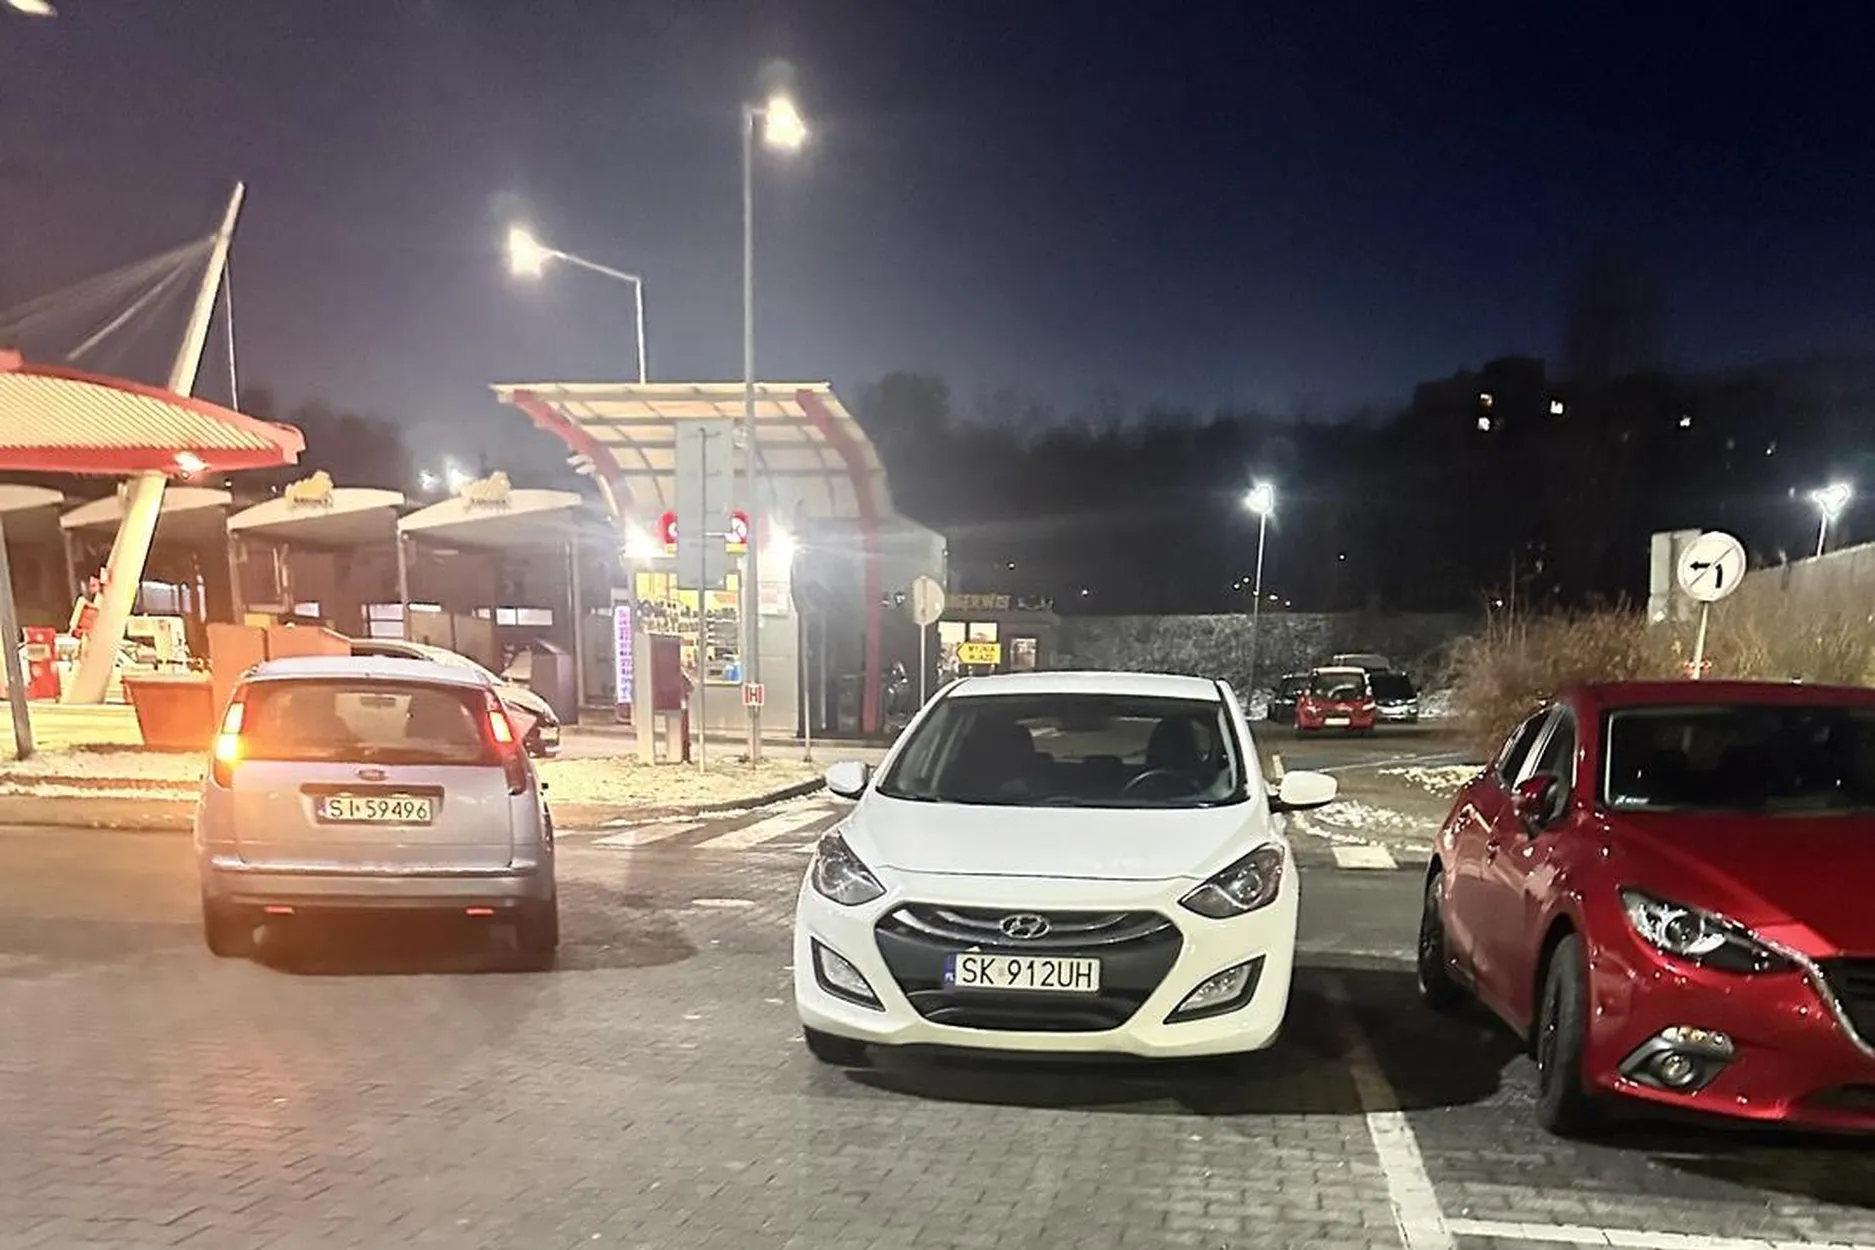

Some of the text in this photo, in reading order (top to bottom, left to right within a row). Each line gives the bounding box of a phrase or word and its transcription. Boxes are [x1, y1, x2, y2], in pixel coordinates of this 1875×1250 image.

[329, 799, 428, 820] SI 59496
[962, 957, 1093, 988] SK 912UH
